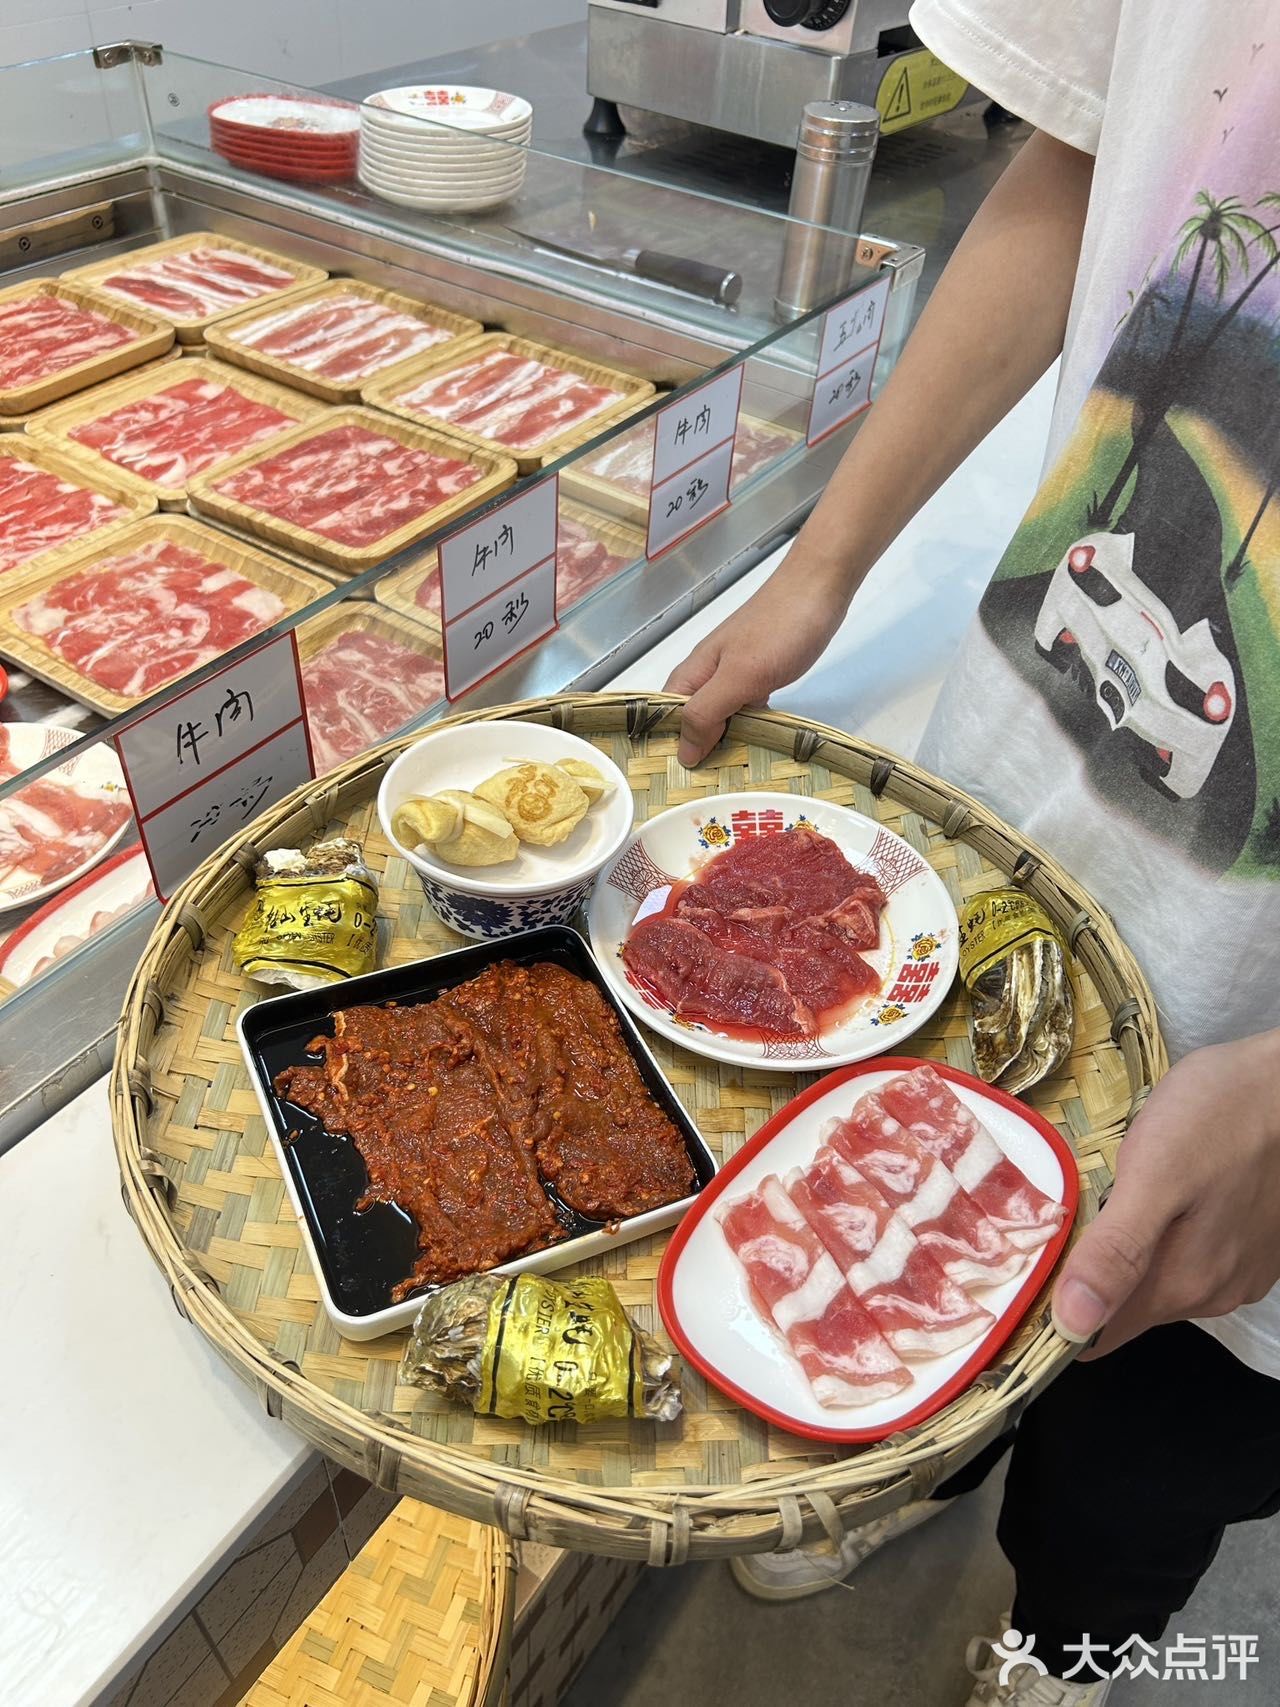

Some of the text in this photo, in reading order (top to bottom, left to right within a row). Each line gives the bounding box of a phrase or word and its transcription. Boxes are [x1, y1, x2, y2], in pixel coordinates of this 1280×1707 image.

[674, 404, 711, 446] 牛肉
[666, 478, 709, 519] 20秒
[472, 524, 515, 577] 牛肉
[474, 592, 530, 651] 20秒
[176, 688, 254, 765] 牛肉
